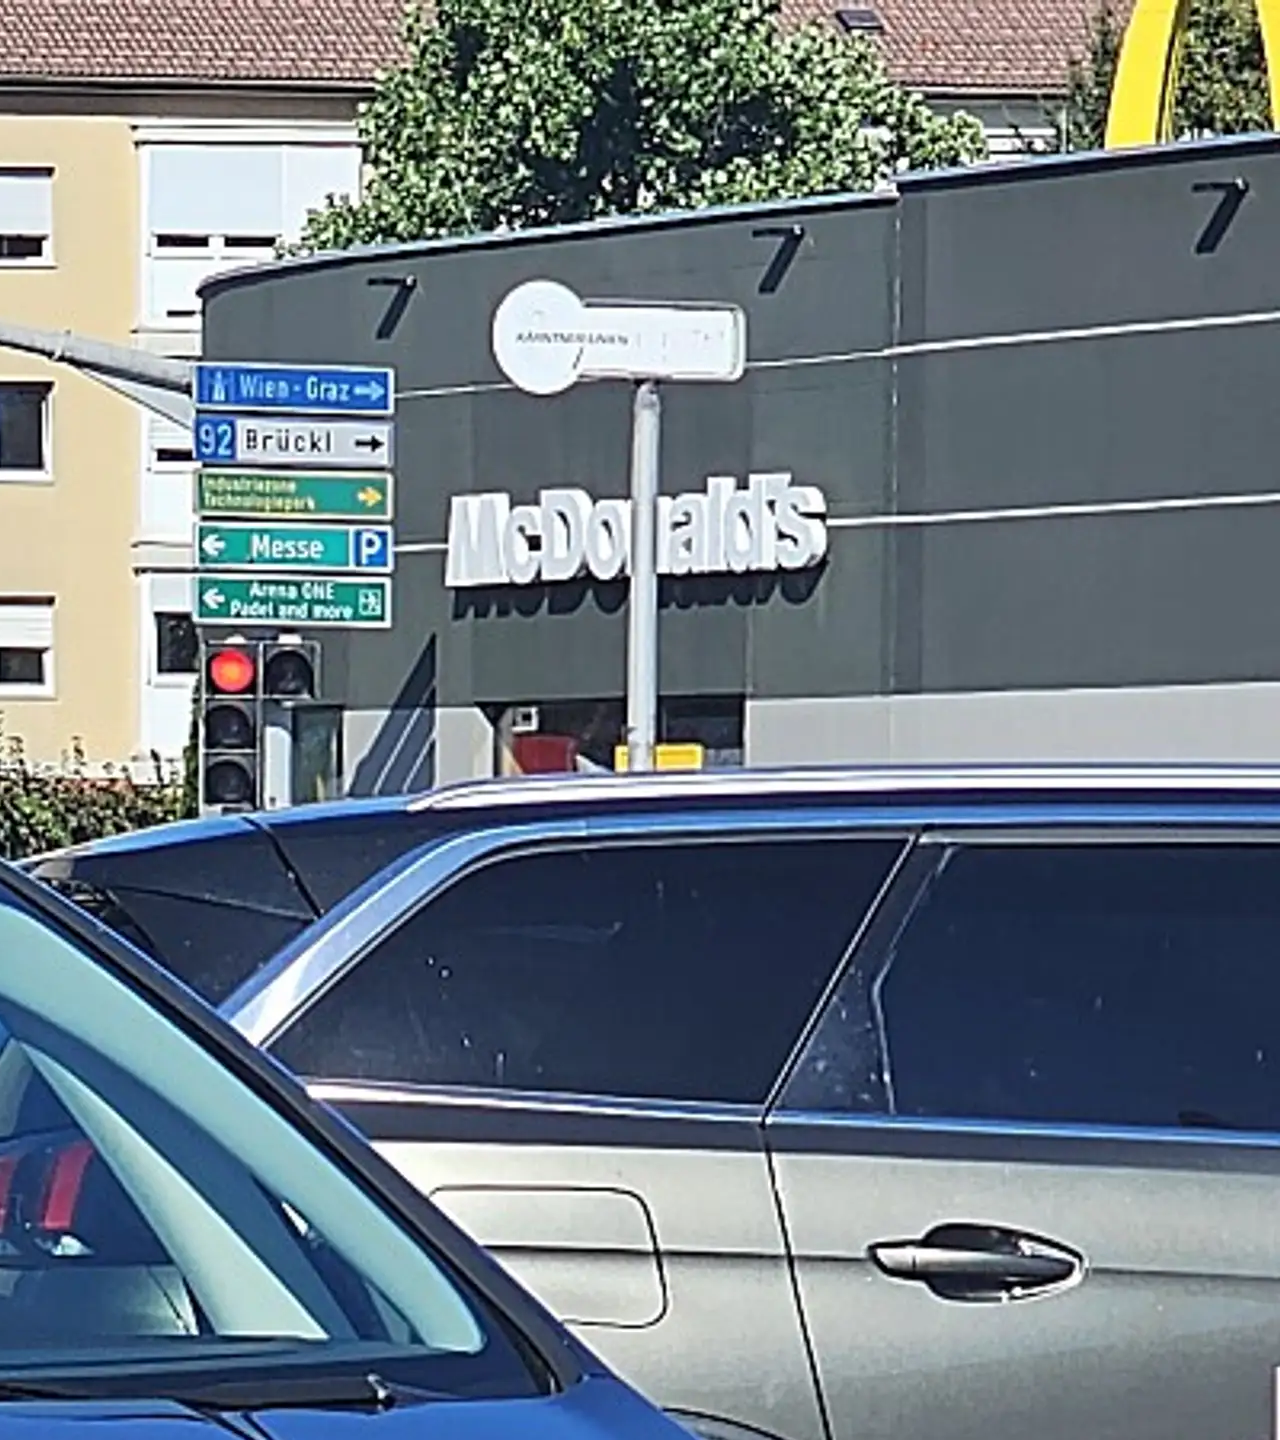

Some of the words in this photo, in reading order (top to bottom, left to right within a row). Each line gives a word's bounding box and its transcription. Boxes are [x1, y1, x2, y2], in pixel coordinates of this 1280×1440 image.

[240, 374, 289, 399] Wien
[306, 376, 351, 401] Graz
[199, 423, 233, 456] 92
[246, 428, 332, 453] Brückl
[445, 473, 828, 588] McDoald's
[251, 533, 325, 559] Messe
[361, 532, 382, 565] P
[249, 581, 299, 600] Arena
[230, 598, 274, 617] Padel
[278, 600, 308, 619] and
[312, 603, 353, 620] more
